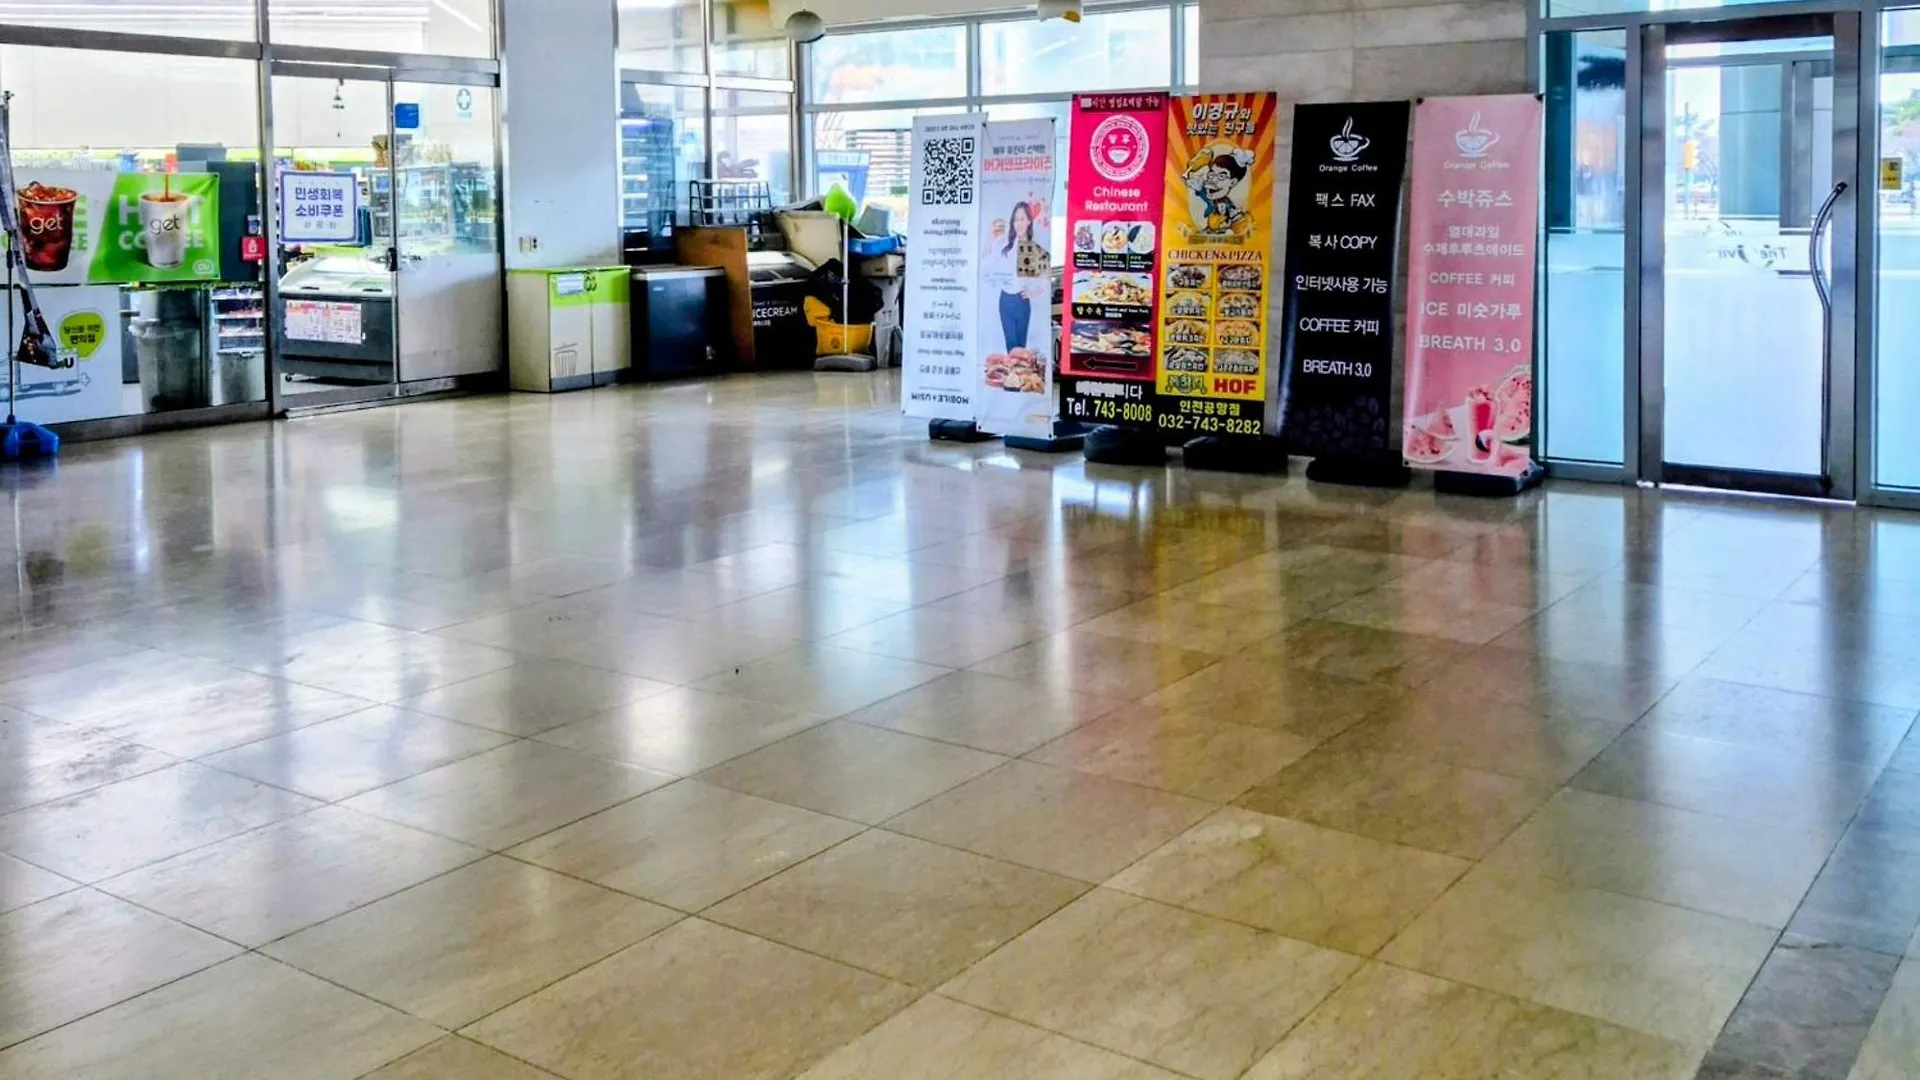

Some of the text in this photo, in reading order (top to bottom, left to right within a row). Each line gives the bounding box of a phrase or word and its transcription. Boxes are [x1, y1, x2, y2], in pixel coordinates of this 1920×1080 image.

[1319, 164, 1378, 173] Orange Coffee
[295, 187, 343, 201] 민생회복
[1093, 186, 1141, 197] Chinese
[1316, 192, 1376, 208] 팩스 FAX
[1437, 189, 1513, 209] 수박쥬스
[295, 204, 343, 218] 소비쿠폰
[1085, 200, 1148, 212] Restaurant
[29, 215, 63, 235] get
[150, 214, 180, 235] get
[1308, 234, 1378, 250] 복사 COPY
[1295, 275, 1389, 294] 인터넷사용 가능
[1428, 272, 1515, 287] COFFEE 커피
[1420, 302, 1522, 320] ICE 미숫가루
[1299, 317, 1380, 336] COFFEE 커피
[1419, 335, 1521, 353] BREATH 3.0
[1303, 359, 1372, 378] BREATH 3.0
[1213, 377, 1257, 394] HOF
[1066, 397, 1153, 422] Tel. 743-8008
[1179, 400, 1240, 417] 인천공항점
[1158, 413, 1261, 435] 032-743-8282
